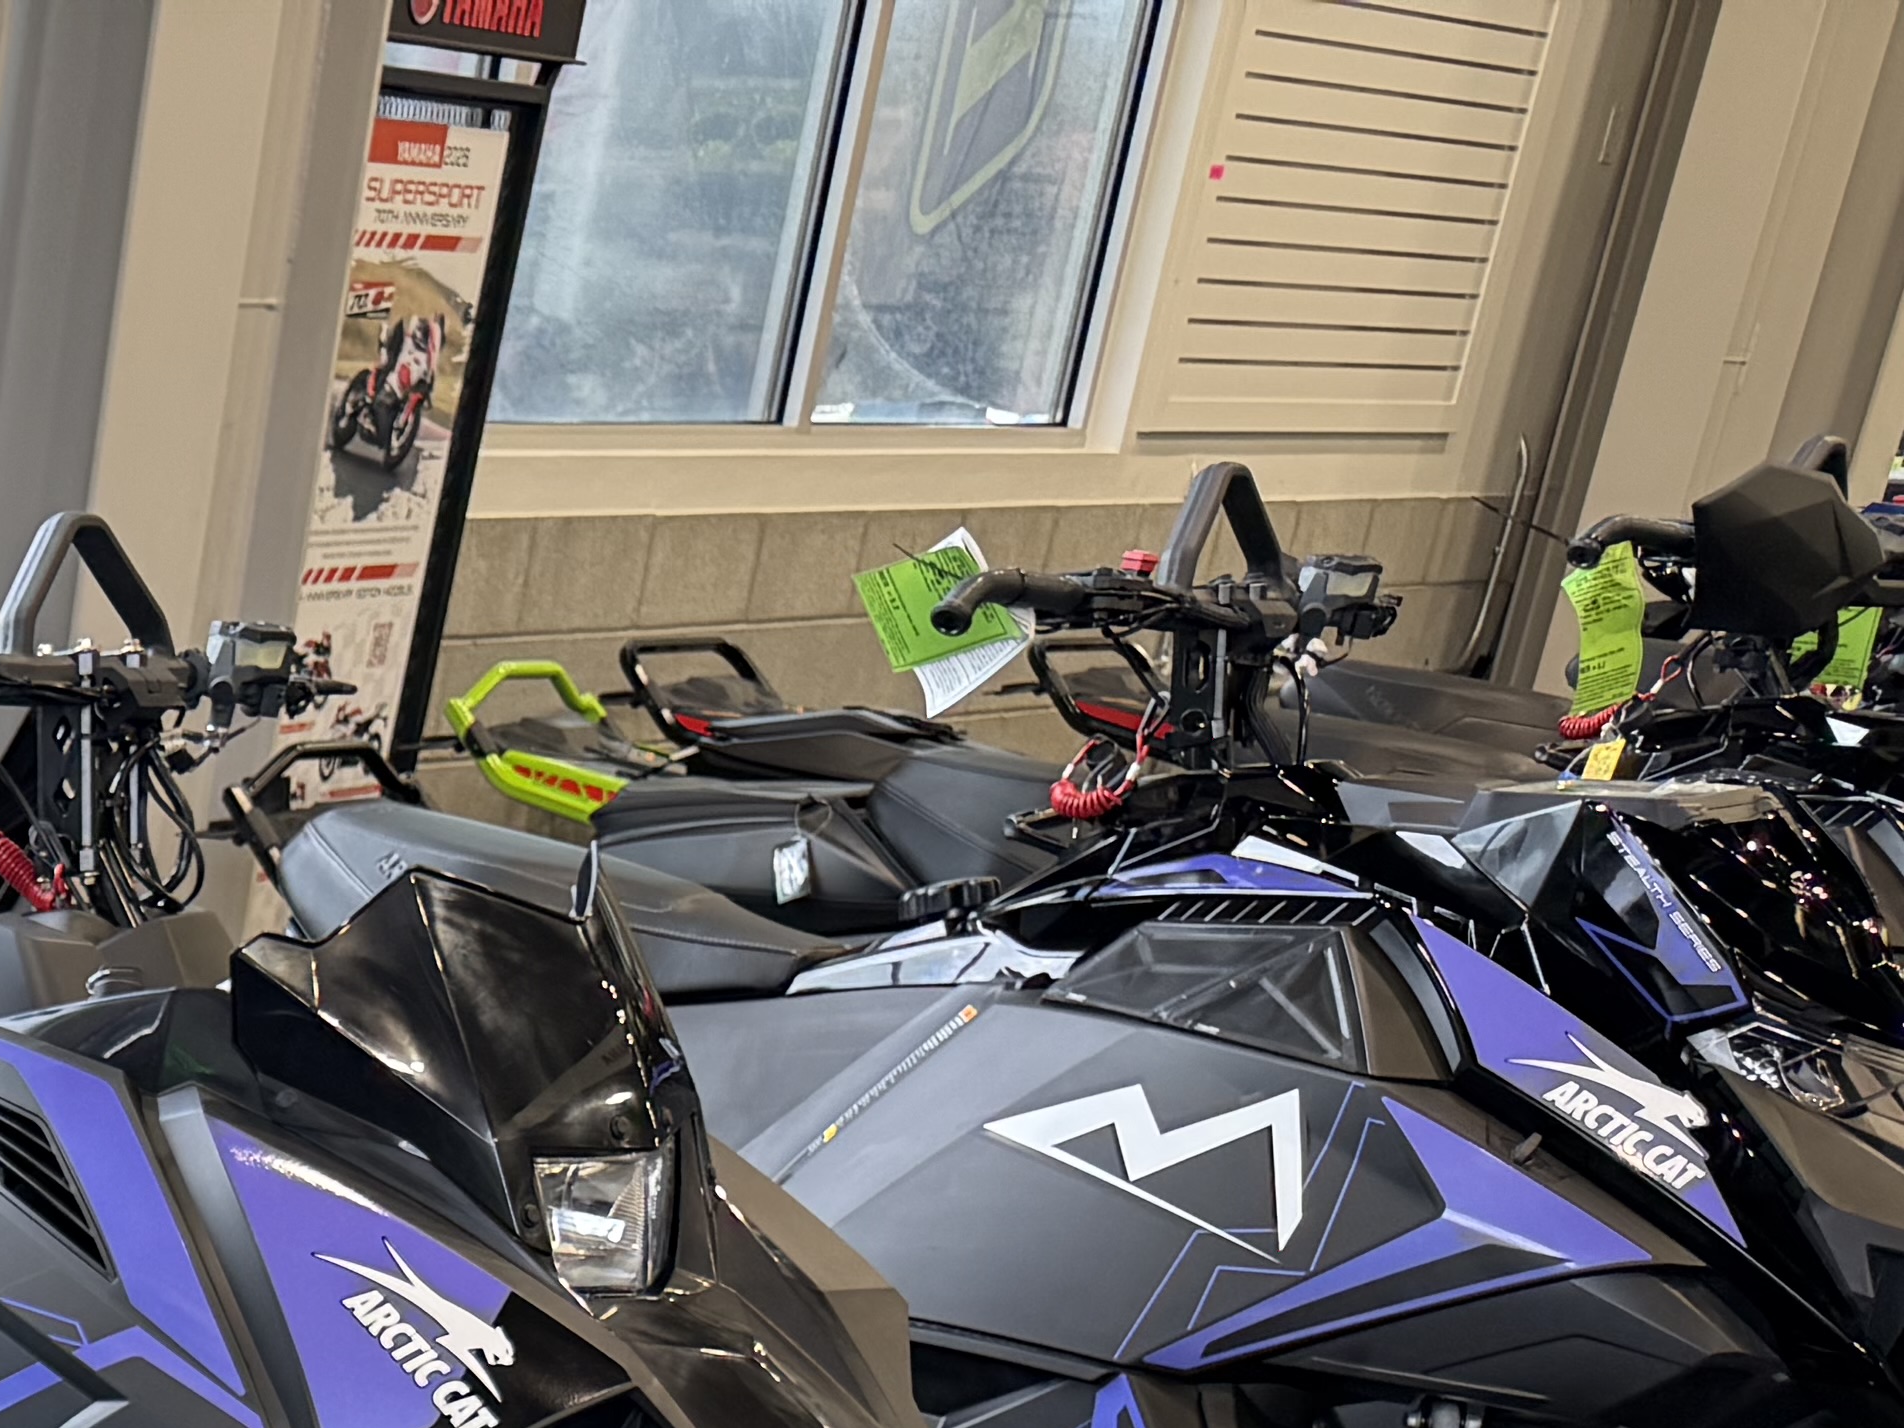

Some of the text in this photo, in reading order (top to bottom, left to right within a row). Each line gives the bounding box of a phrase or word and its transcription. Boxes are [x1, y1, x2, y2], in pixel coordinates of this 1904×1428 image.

[365, 176, 485, 210] SUPERSPORT
[1606, 831, 1721, 972] STEALTH SERIES
[1542, 1081, 1706, 1189] ARCTIC CAT
[342, 1290, 451, 1388] ARCTIC
